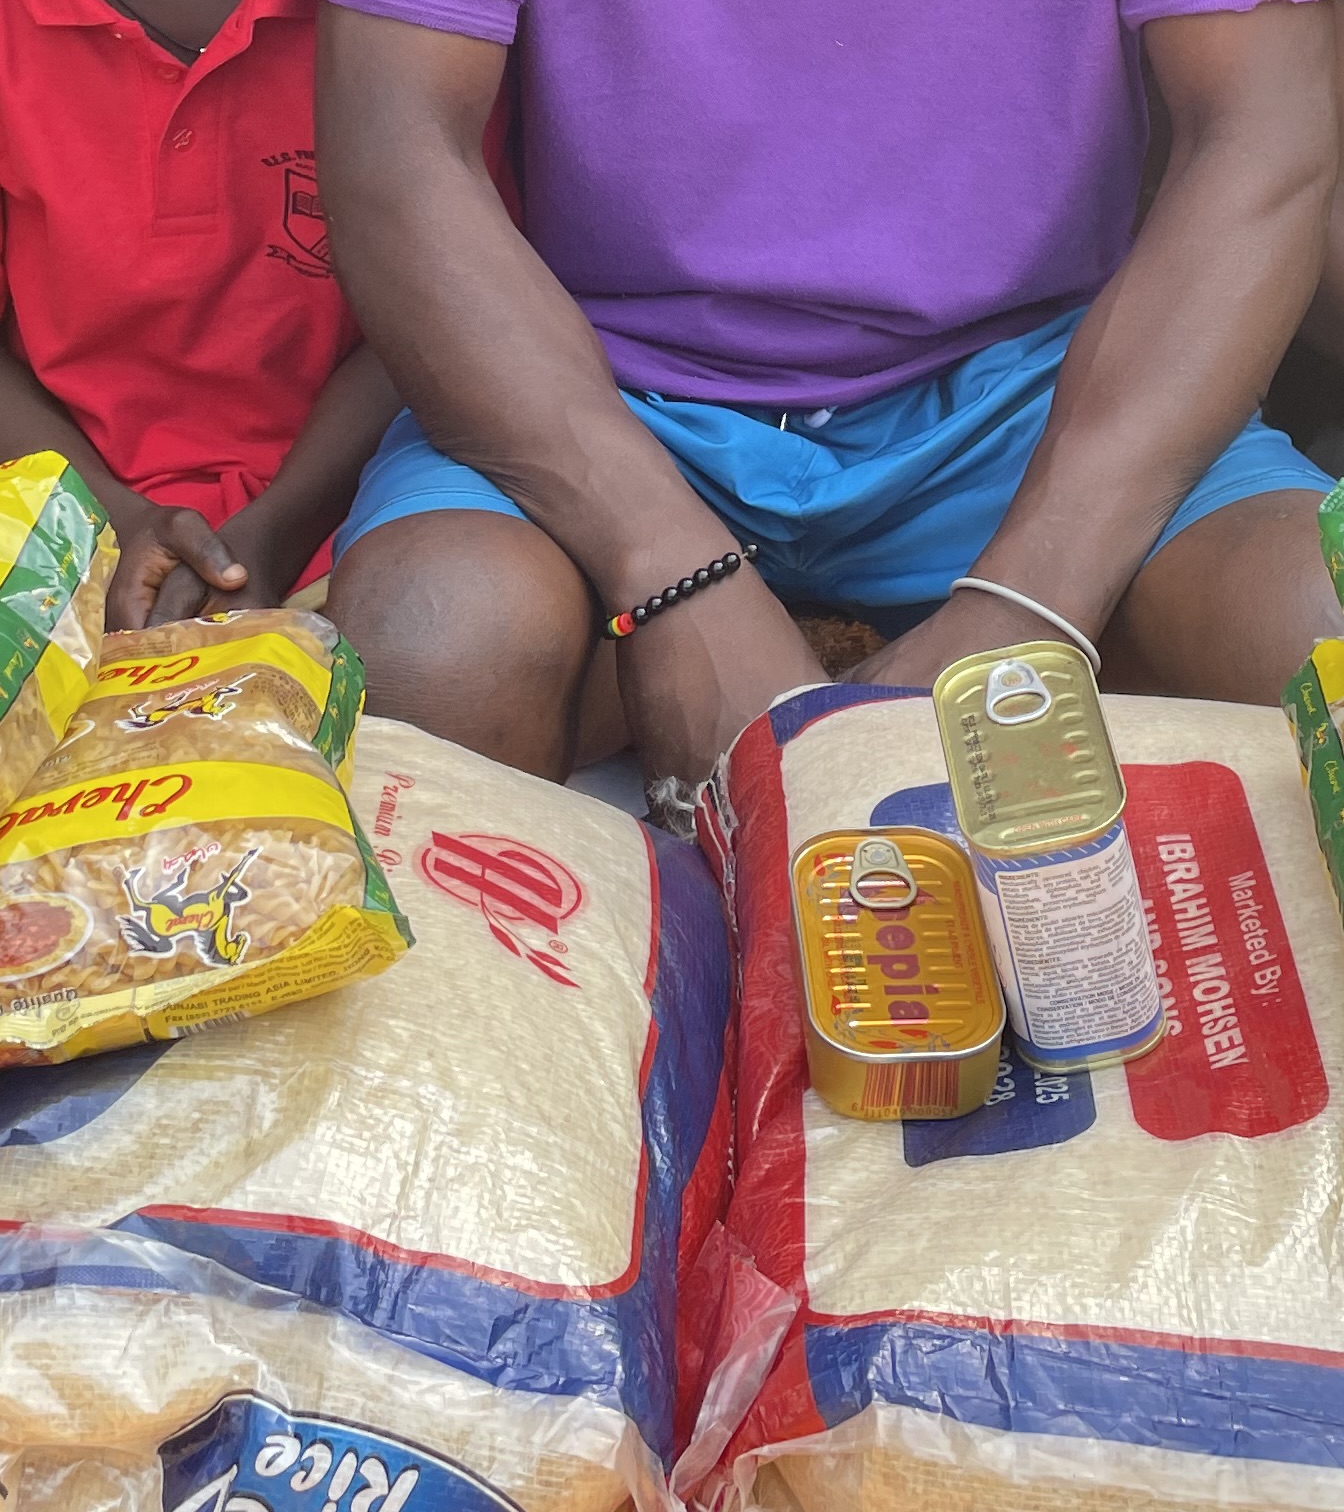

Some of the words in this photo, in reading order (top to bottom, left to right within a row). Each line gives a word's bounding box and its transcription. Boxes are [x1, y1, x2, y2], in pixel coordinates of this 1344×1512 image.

[373, 770, 416, 837] Premium
[1156, 833, 1218, 951] IBRAHIM
[1228, 870, 1278, 966] Marketed
[1185, 952, 1249, 1070] MOHSEN
[1251, 965, 1281, 995] By
[254, 1433, 421, 1512] Rice
